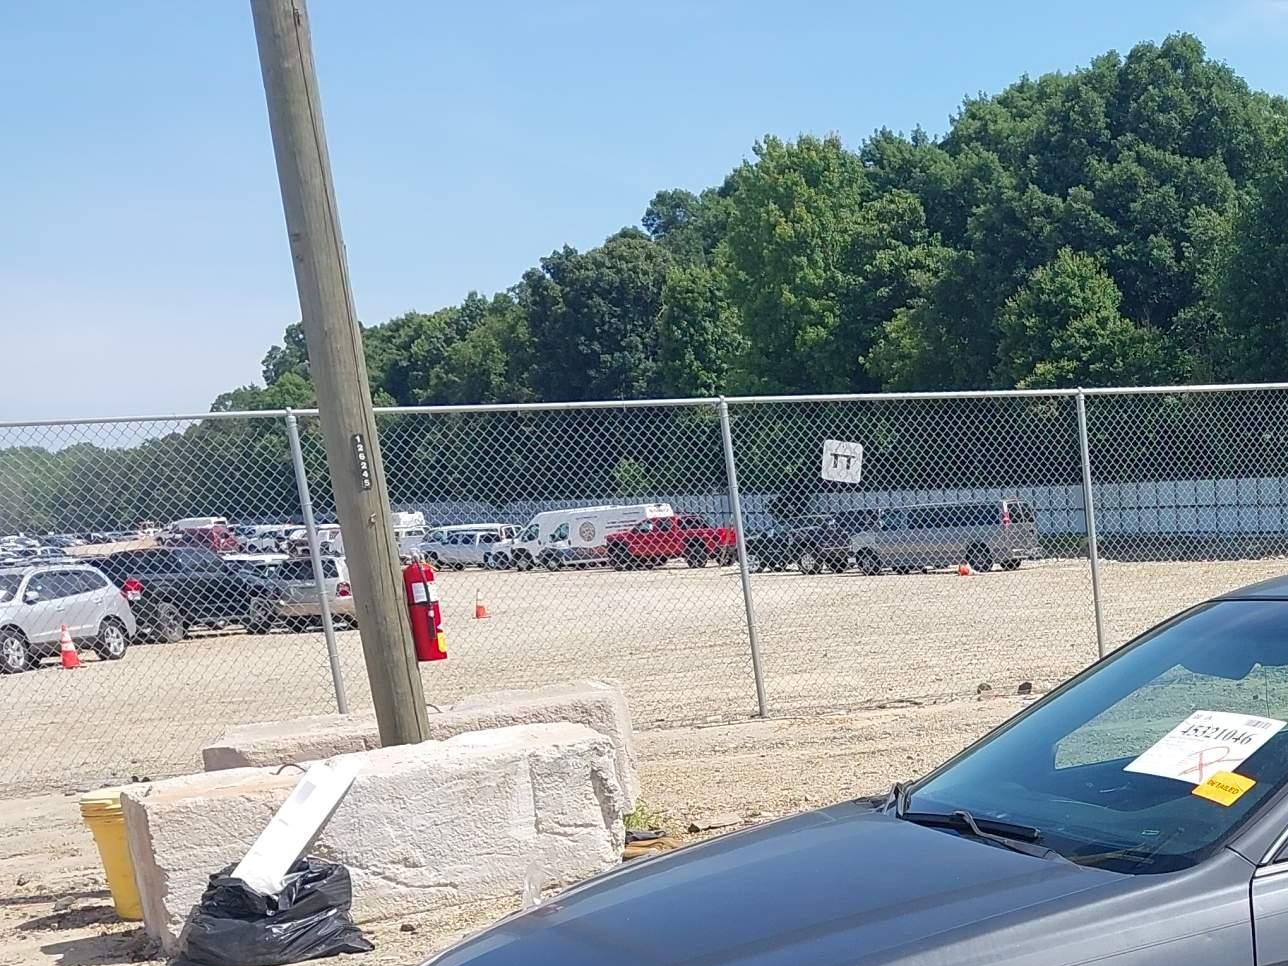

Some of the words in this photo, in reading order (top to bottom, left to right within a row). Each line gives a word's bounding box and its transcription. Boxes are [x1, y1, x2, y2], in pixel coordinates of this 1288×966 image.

[355, 435, 370, 487] 126245
[830, 453, 856, 470] TT
[1180, 725, 1257, 745] 45321046
